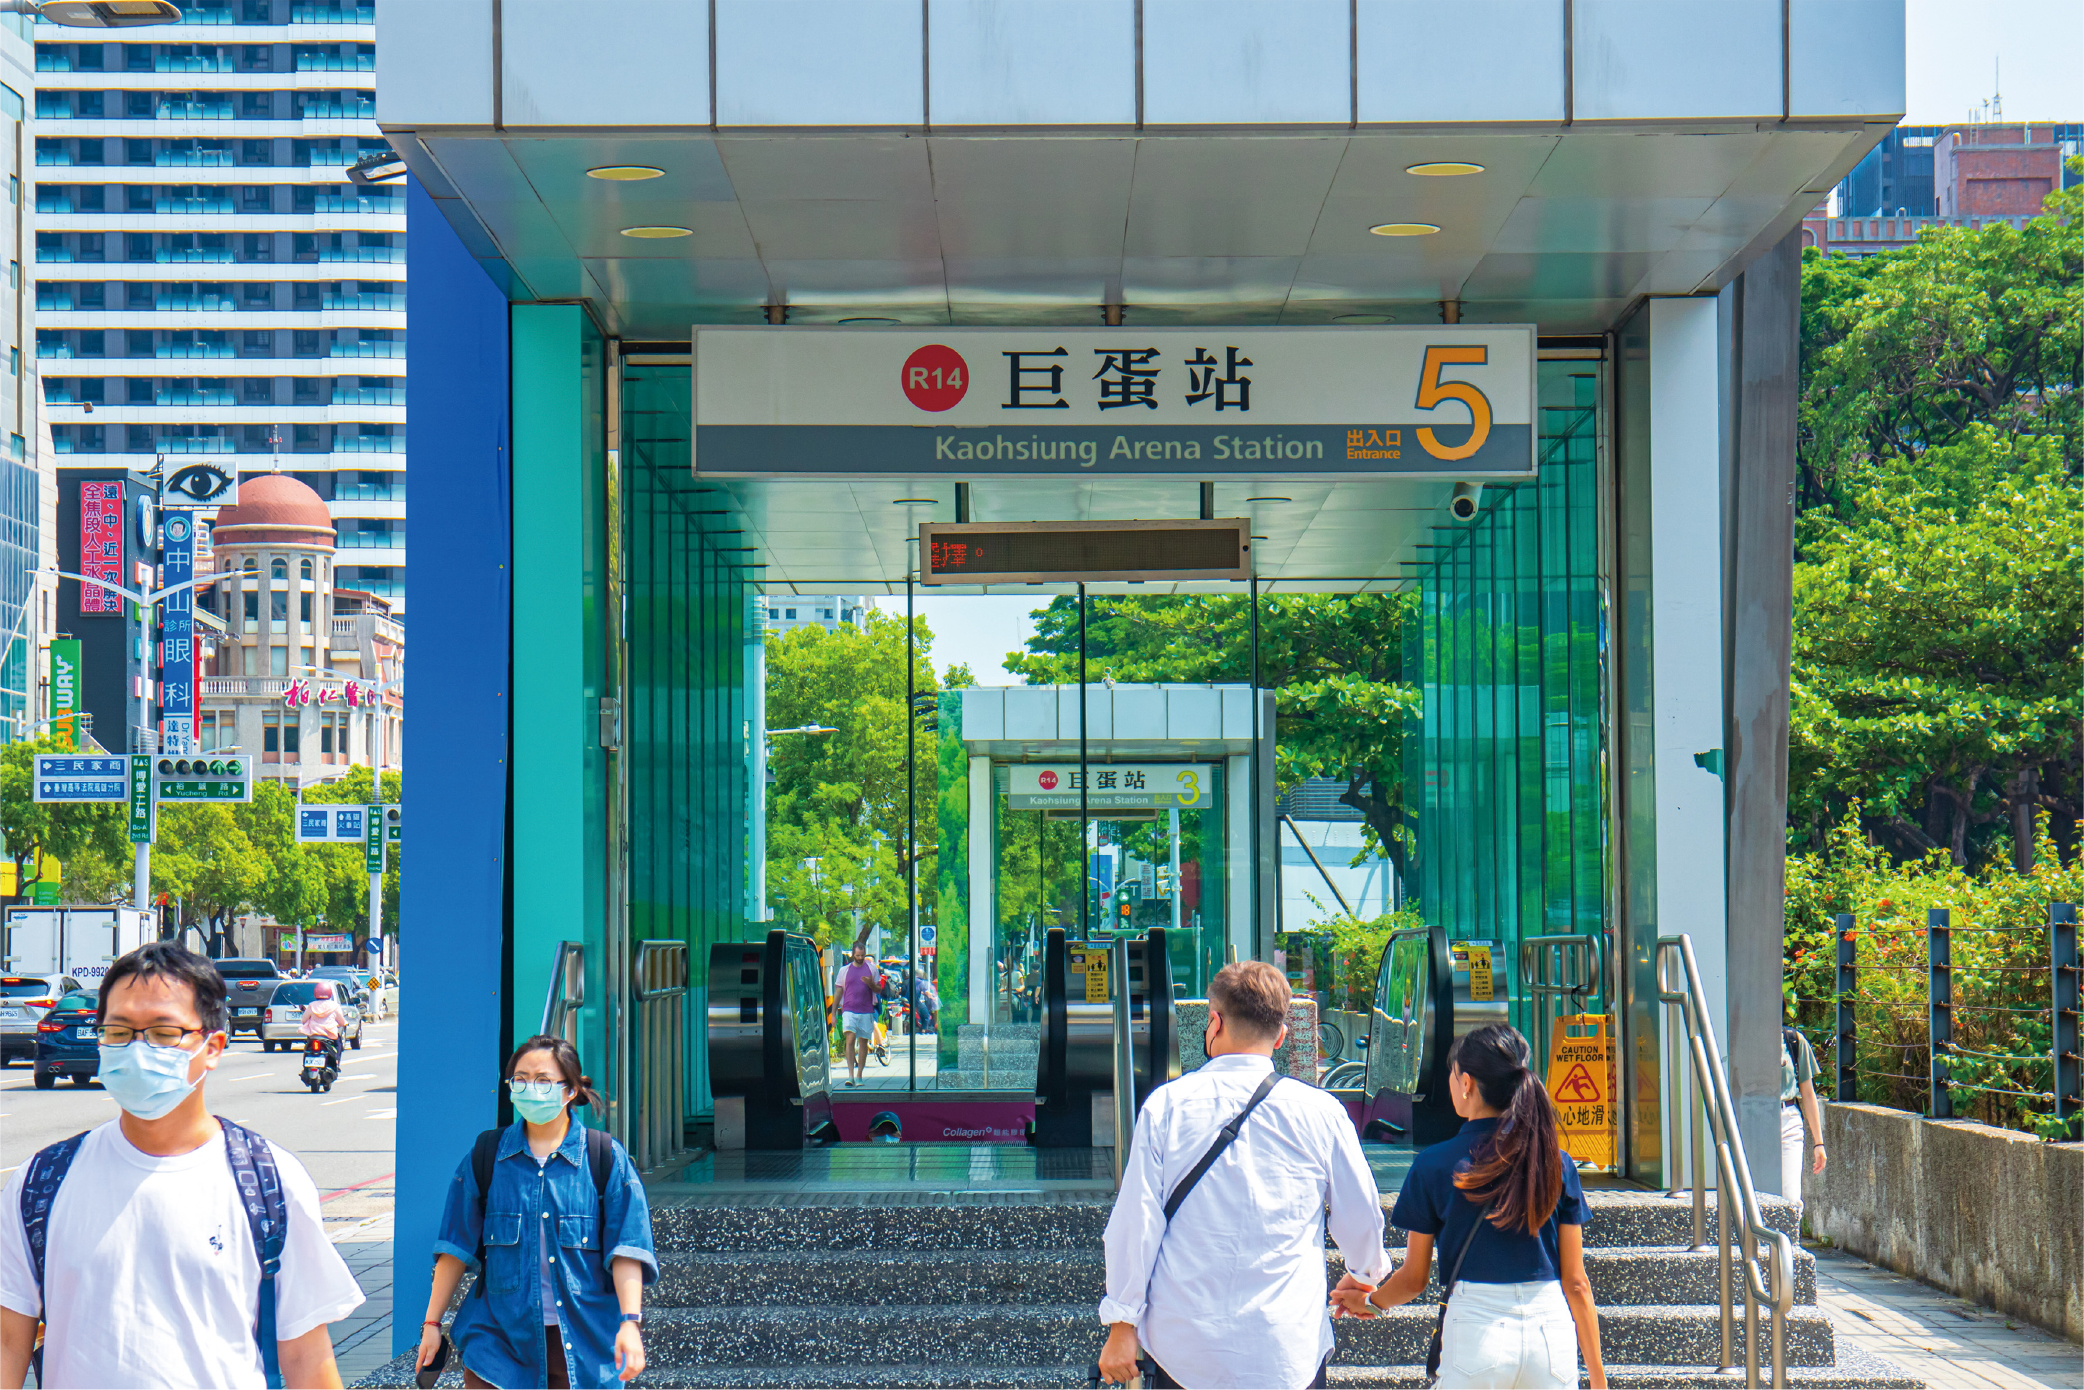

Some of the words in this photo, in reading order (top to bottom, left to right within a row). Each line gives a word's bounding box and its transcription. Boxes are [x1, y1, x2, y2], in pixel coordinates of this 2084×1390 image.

[908, 366, 963, 390] R14
[1001, 346, 1254, 412] 巨蛋站
[1414, 343, 1494, 462] 5
[1346, 429, 1402, 447] 出入口
[935, 434, 1098, 467] Kaohsiung
[1108, 434, 1201, 461] Arena
[1212, 434, 1324, 461] Station
[1346, 447, 1401, 460] Entrance
[54, 653, 75, 753] SUBWAY
[54, 760, 121, 771] 三民家商
[1040, 776, 1057, 784] R14
[1068, 770, 1146, 790] 巨蛋站
[1176, 770, 1201, 805] 3
[175, 790, 208, 798] Yucheng
[1029, 796, 1081, 806] Kaohsiung
[1114, 796, 1149, 805] Station
[1556, 1054, 1576, 1062] WET
[1575, 1053, 1604, 1062] FLOOR
[1561, 1046, 1599, 1054] CAUTION
[1555, 1104, 1605, 1126] 心地滑
[942, 1127, 986, 1139] Collagen
